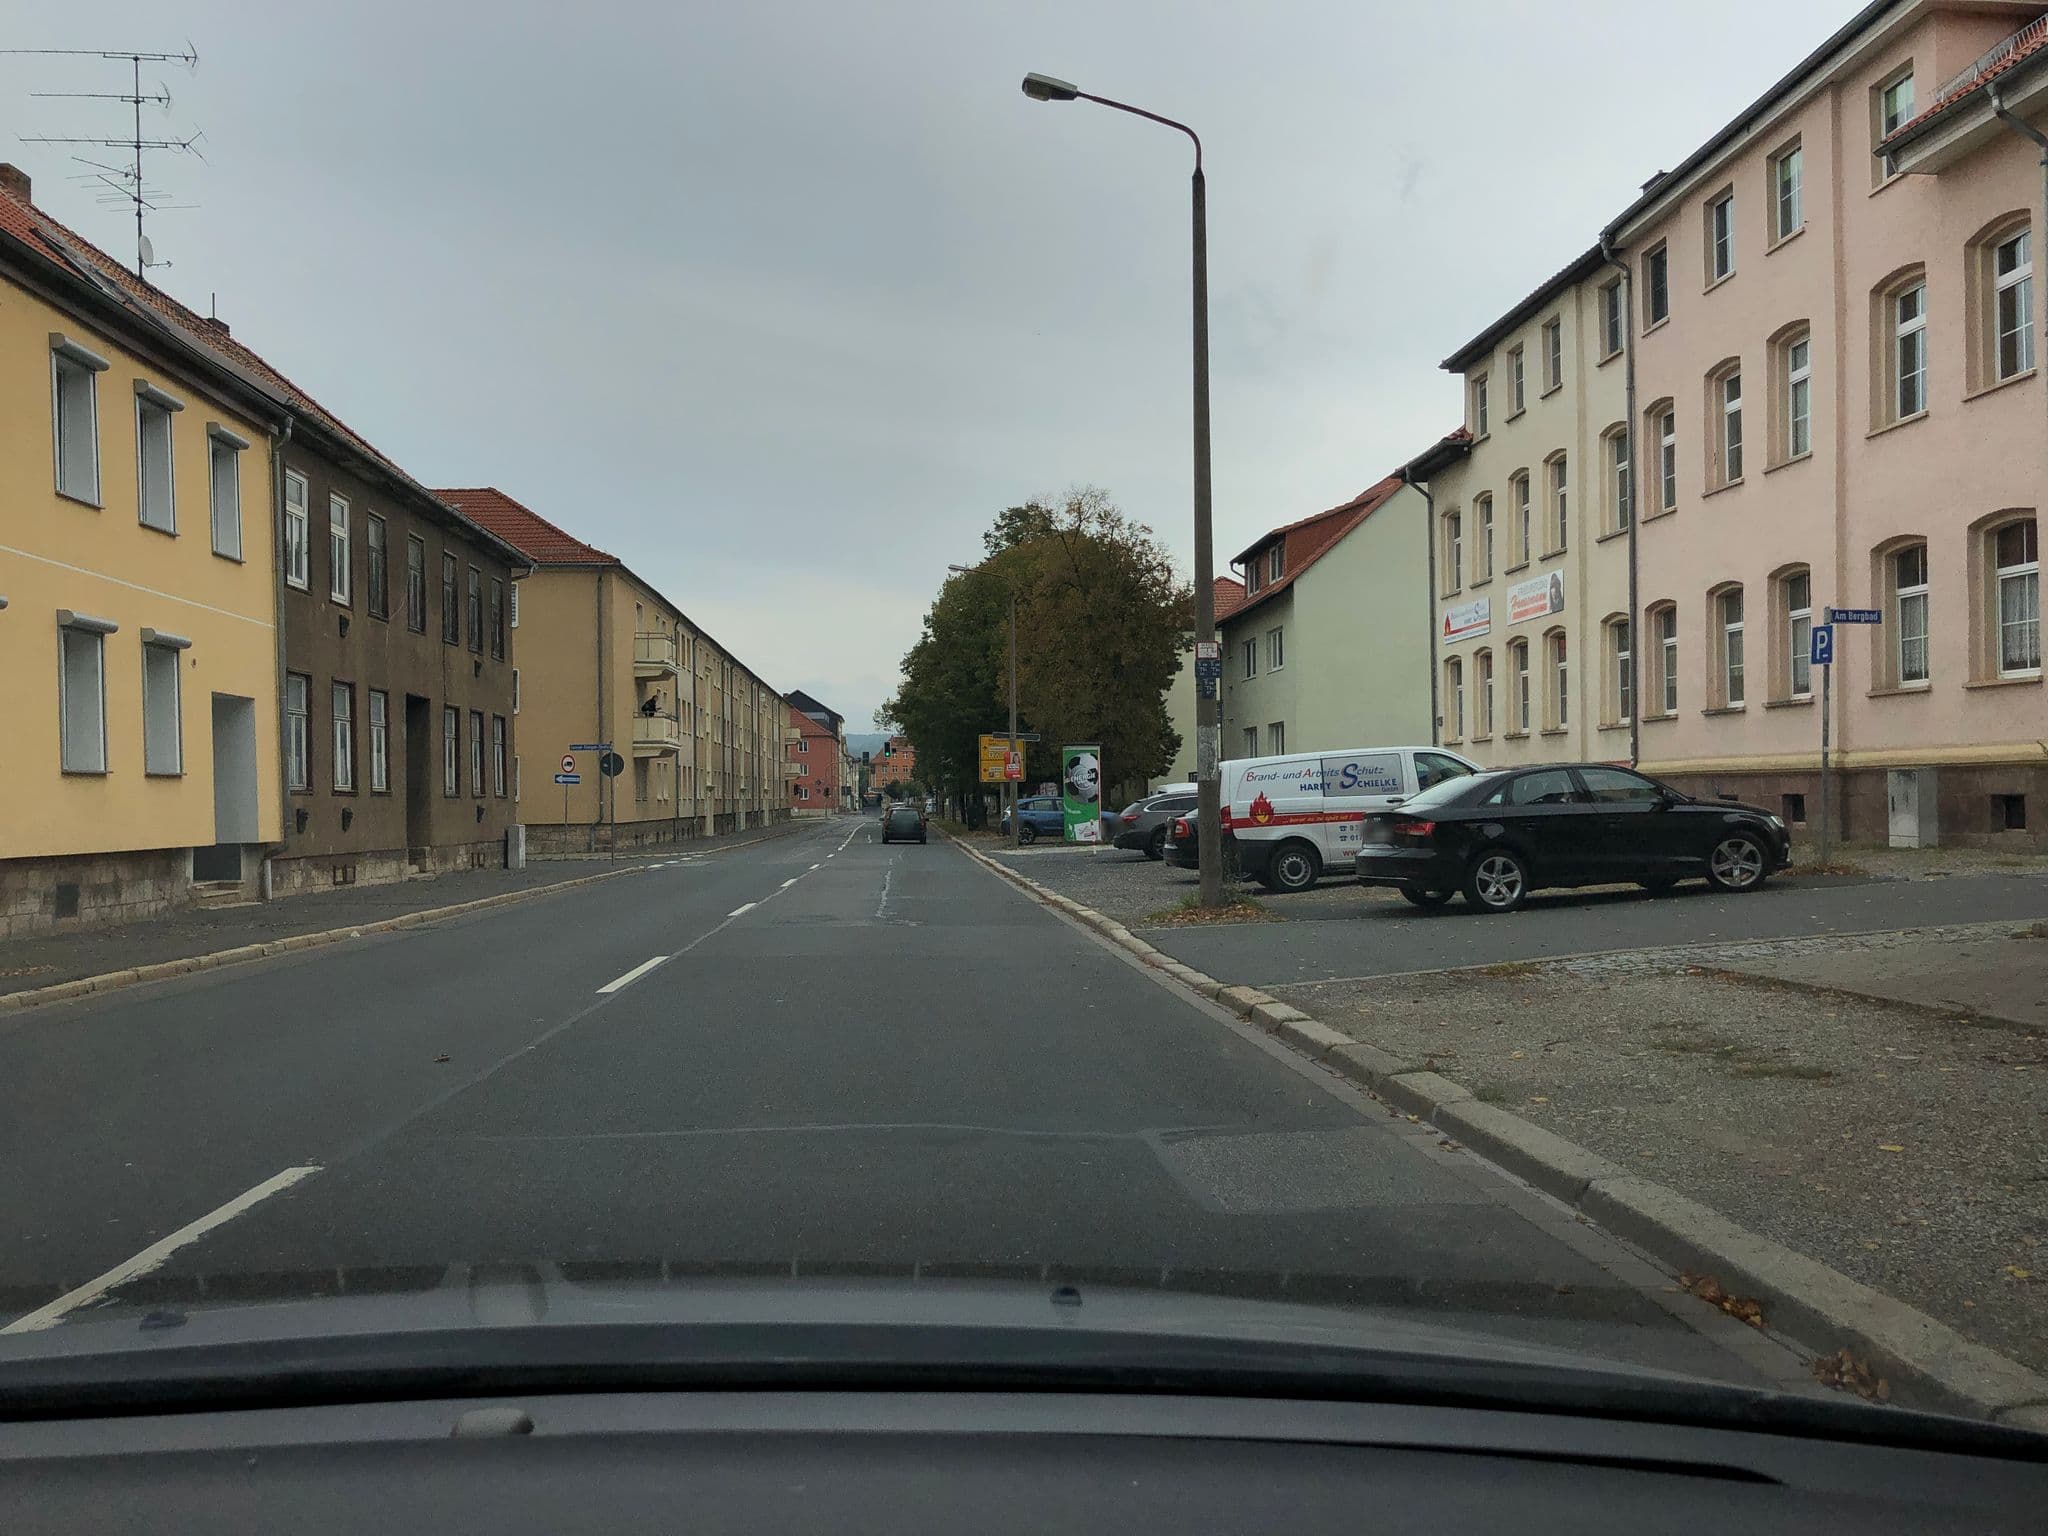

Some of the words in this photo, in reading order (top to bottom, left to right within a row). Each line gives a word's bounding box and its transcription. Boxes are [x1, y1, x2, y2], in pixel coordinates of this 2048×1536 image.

[1834, 611, 1847, 620] Am
[1848, 611, 1878, 622] Bergbad
[1816, 631, 1828, 659] P
[1246, 771, 1280, 782] Brand-
[1282, 771, 1302, 780] und
[1300, 782, 1332, 792] HARRY
